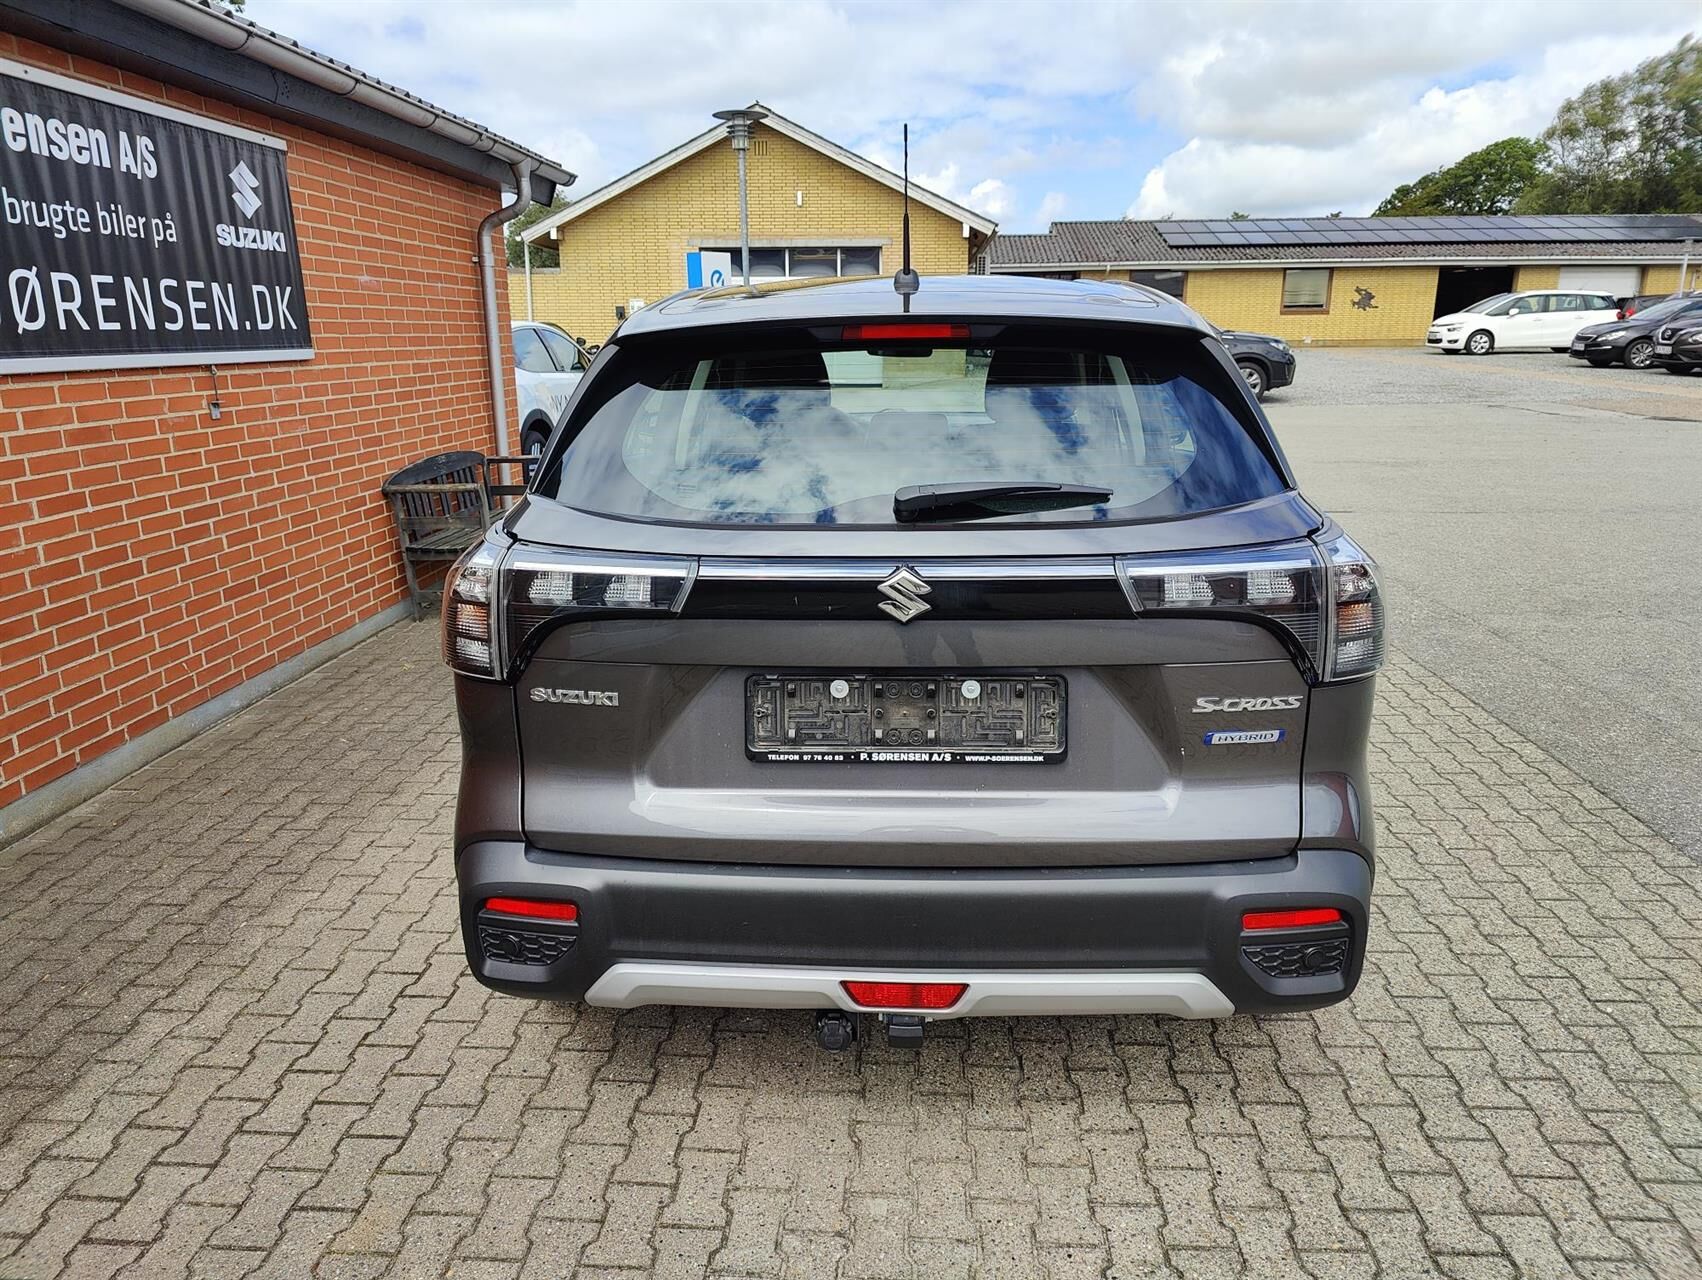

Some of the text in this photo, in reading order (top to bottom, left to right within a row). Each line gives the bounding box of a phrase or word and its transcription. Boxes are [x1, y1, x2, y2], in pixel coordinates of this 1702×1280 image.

[119, 131, 158, 180] A/S
[1, 186, 177, 248] brugte biler på
[215, 223, 287, 253] SUZUKI
[0, 265, 298, 335] ØRENSEN.DK
[529, 687, 619, 707] SUZUKI
[1191, 695, 1304, 714] S-CROSS
[1217, 733, 1275, 742] HYBRID
[860, 752, 869, 761] P.
[871, 752, 929, 762] SØRENSEN
[931, 753, 952, 762] A/S
